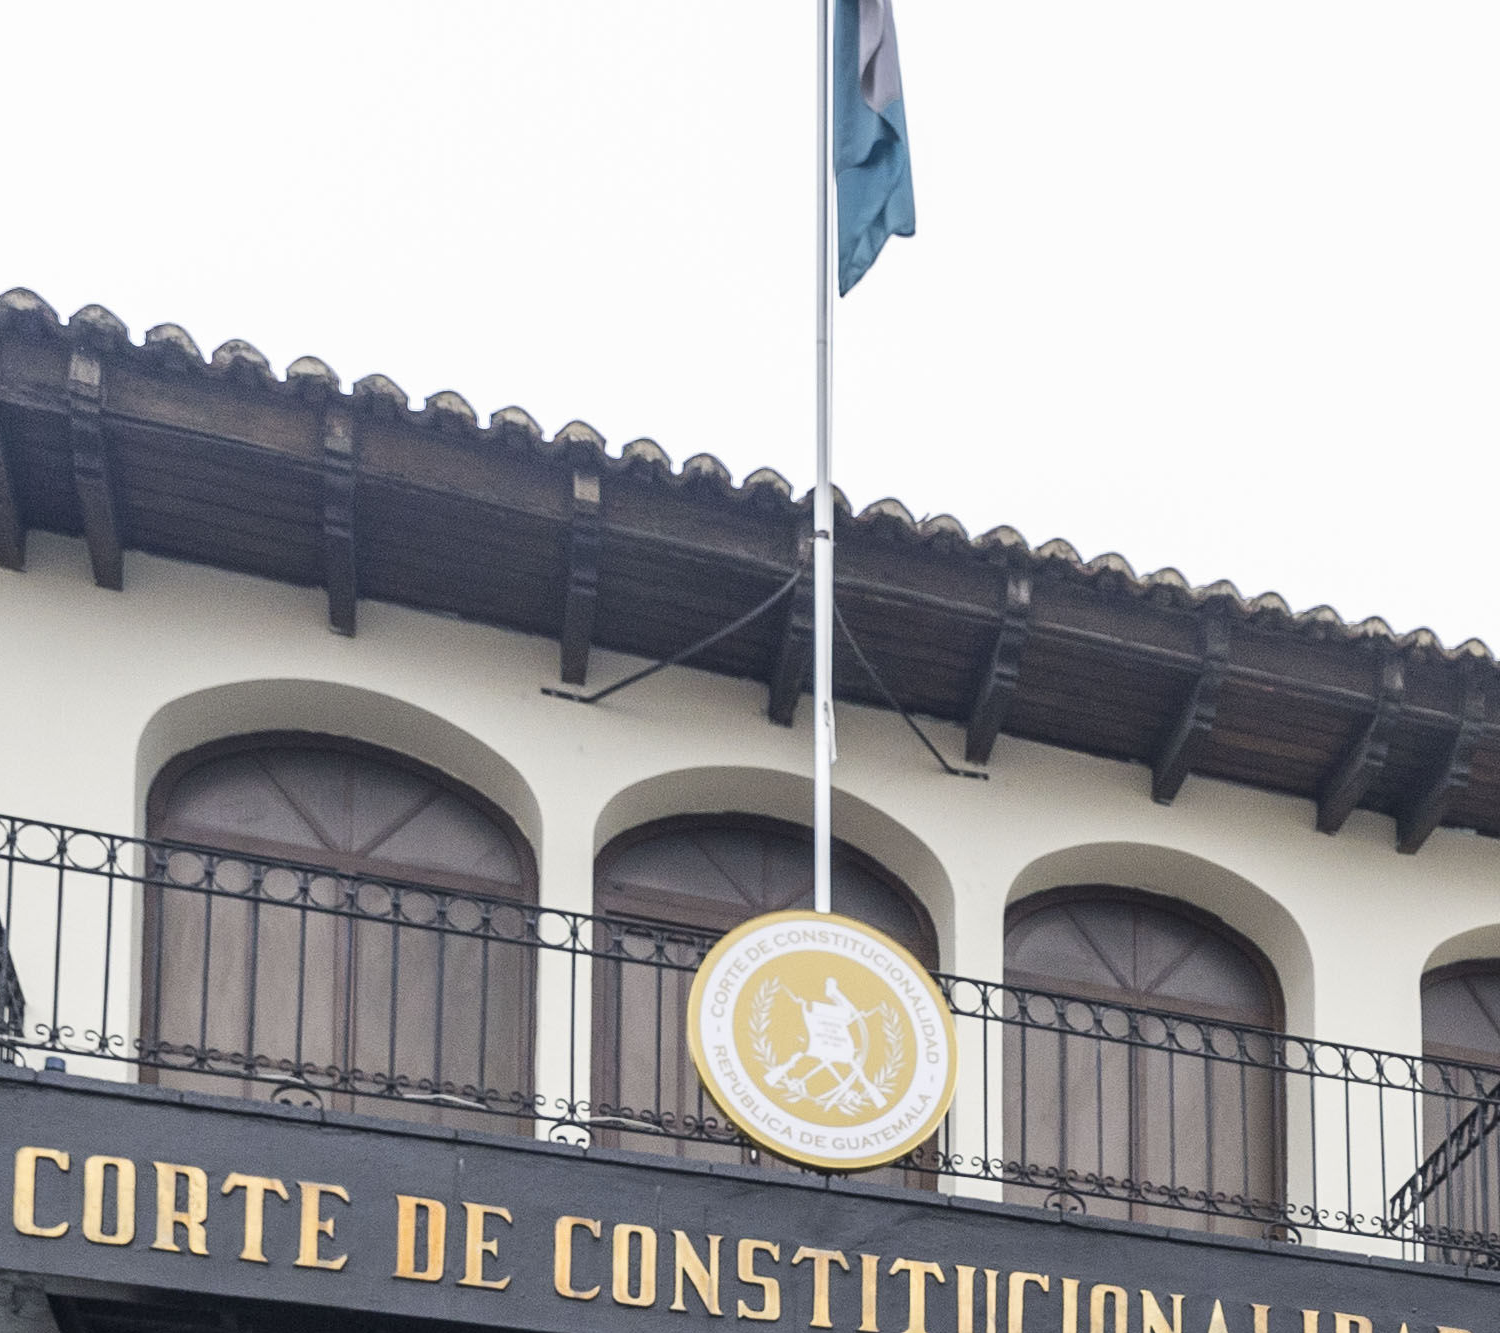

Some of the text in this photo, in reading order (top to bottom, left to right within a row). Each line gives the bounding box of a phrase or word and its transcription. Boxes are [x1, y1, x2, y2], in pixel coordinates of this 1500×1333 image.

[710, 957, 748, 1018] CORTE
[746, 939, 773, 962] DE
[773, 930, 940, 1064] CONSTITUCIONALIDAD
[798, 1131, 828, 1149] DE
[831, 1093, 933, 1150] GUATEMALA
[12, 1145, 350, 1271] CORTE
[392, 1193, 513, 1291] DE
